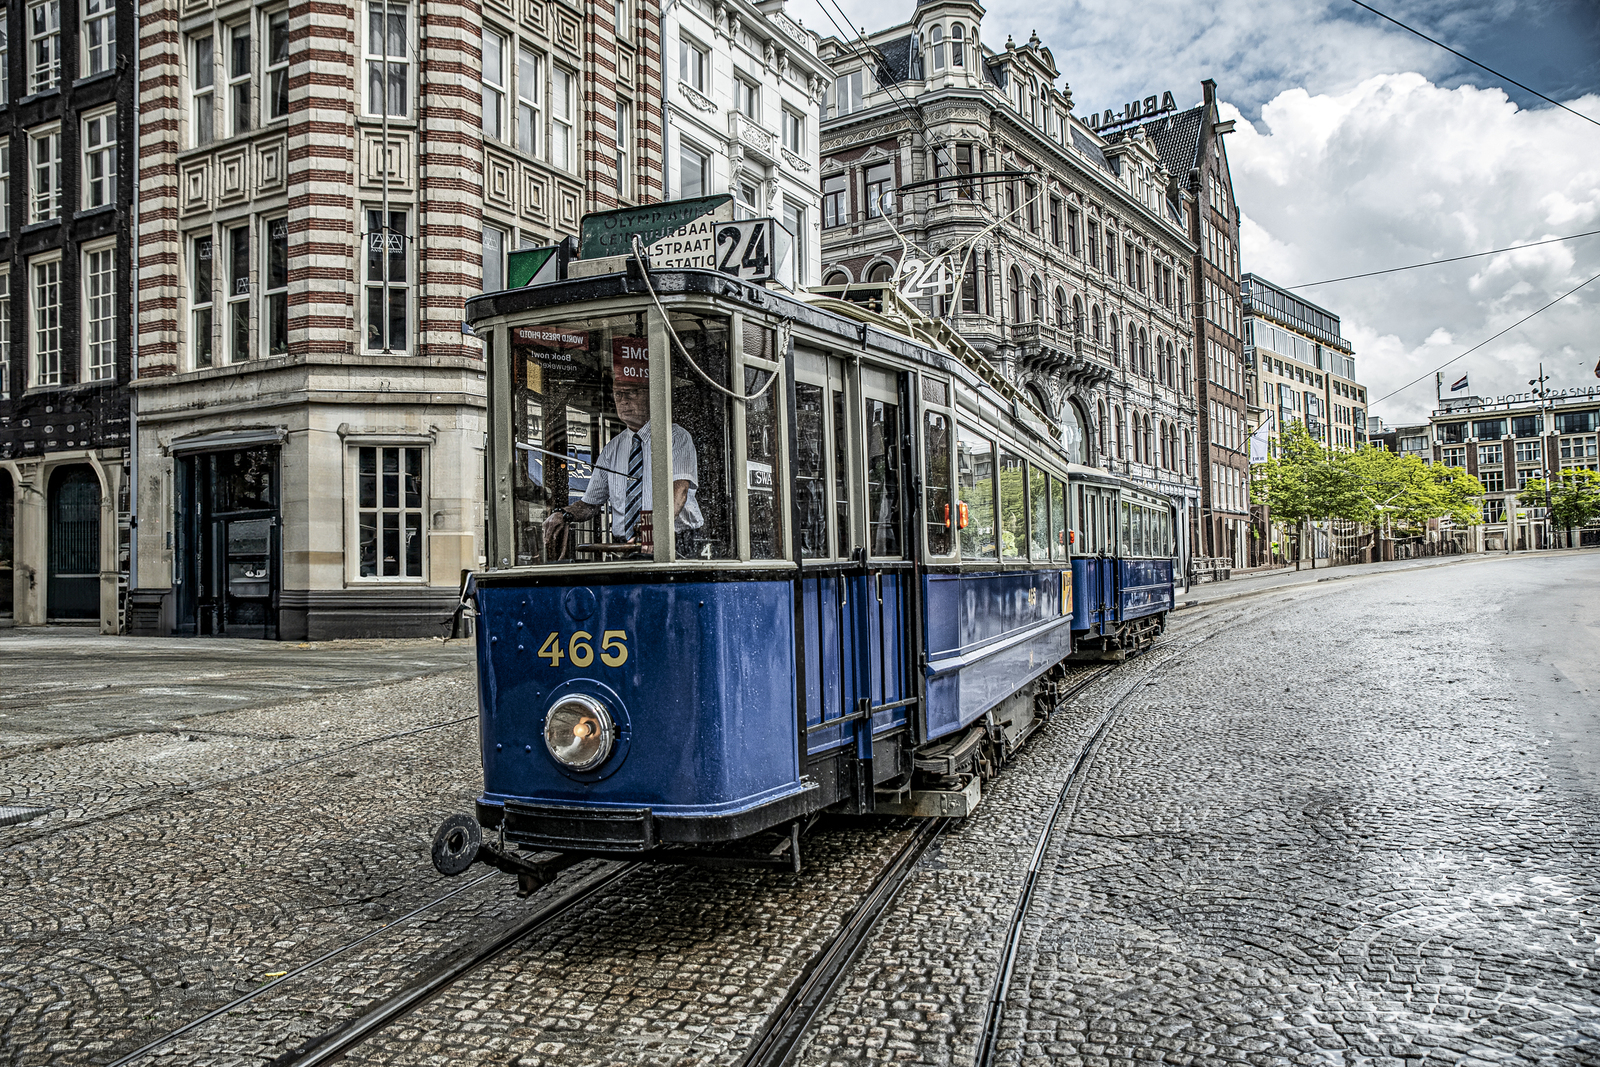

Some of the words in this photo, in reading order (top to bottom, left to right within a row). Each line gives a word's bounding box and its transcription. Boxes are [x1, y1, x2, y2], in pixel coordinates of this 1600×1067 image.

[665, 255, 714, 267] STATIO
[717, 223, 769, 276] 24
[901, 256, 952, 297] 24
[701, 543, 712, 560] 4
[537, 629, 628, 668] 465
